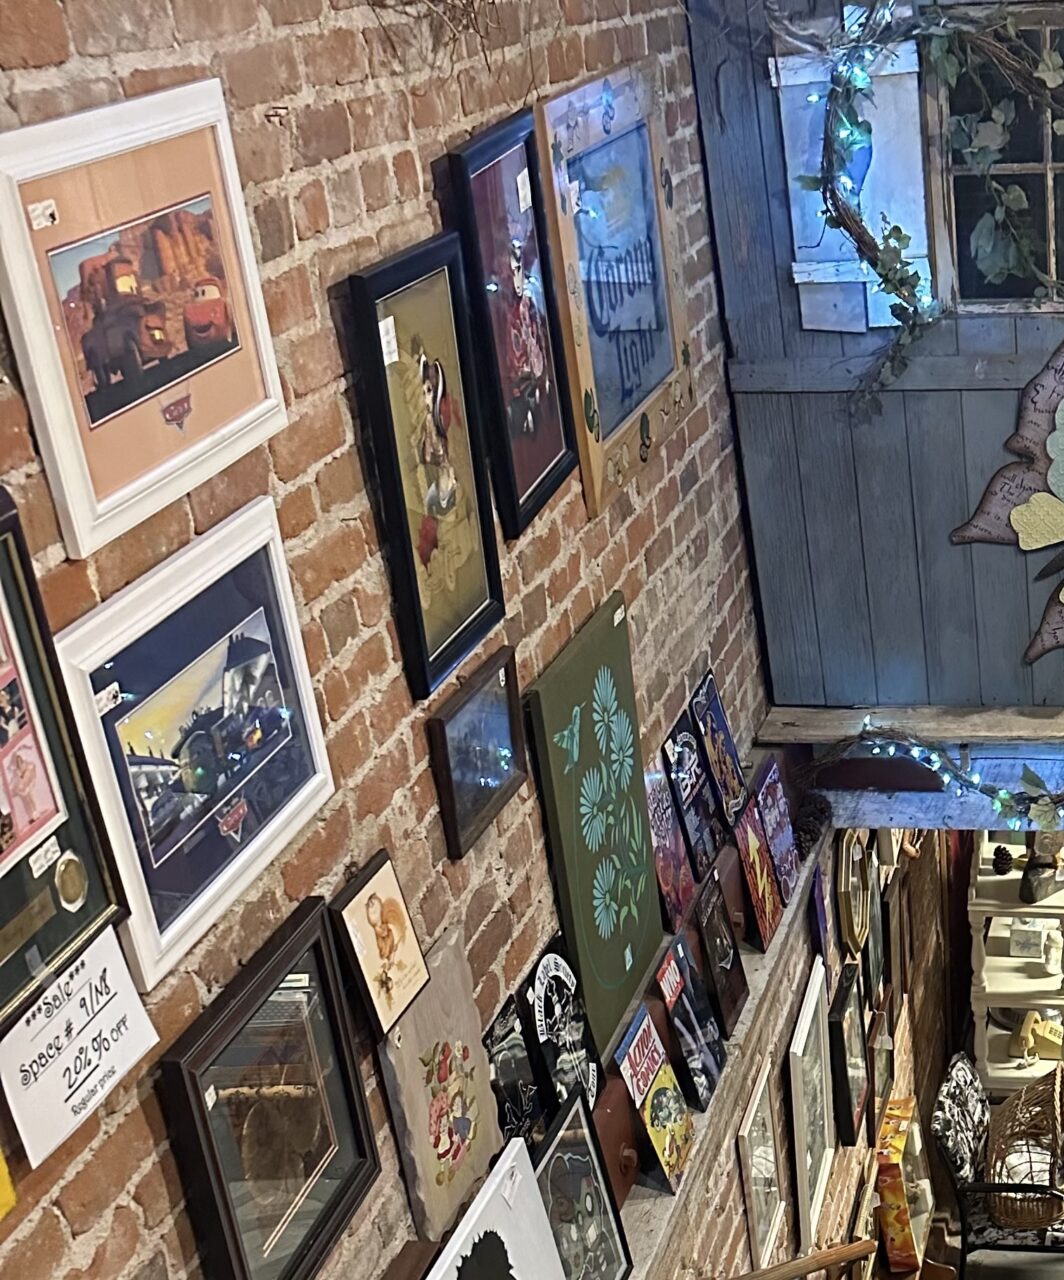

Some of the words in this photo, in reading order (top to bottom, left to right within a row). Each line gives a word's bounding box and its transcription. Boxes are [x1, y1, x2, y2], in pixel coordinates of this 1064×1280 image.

[110, 1014, 129, 1043] OFF
[19, 1034, 63, 1087] Space
[64, 1018, 74, 1041] #
[71, 1083, 100, 1117] Regular
